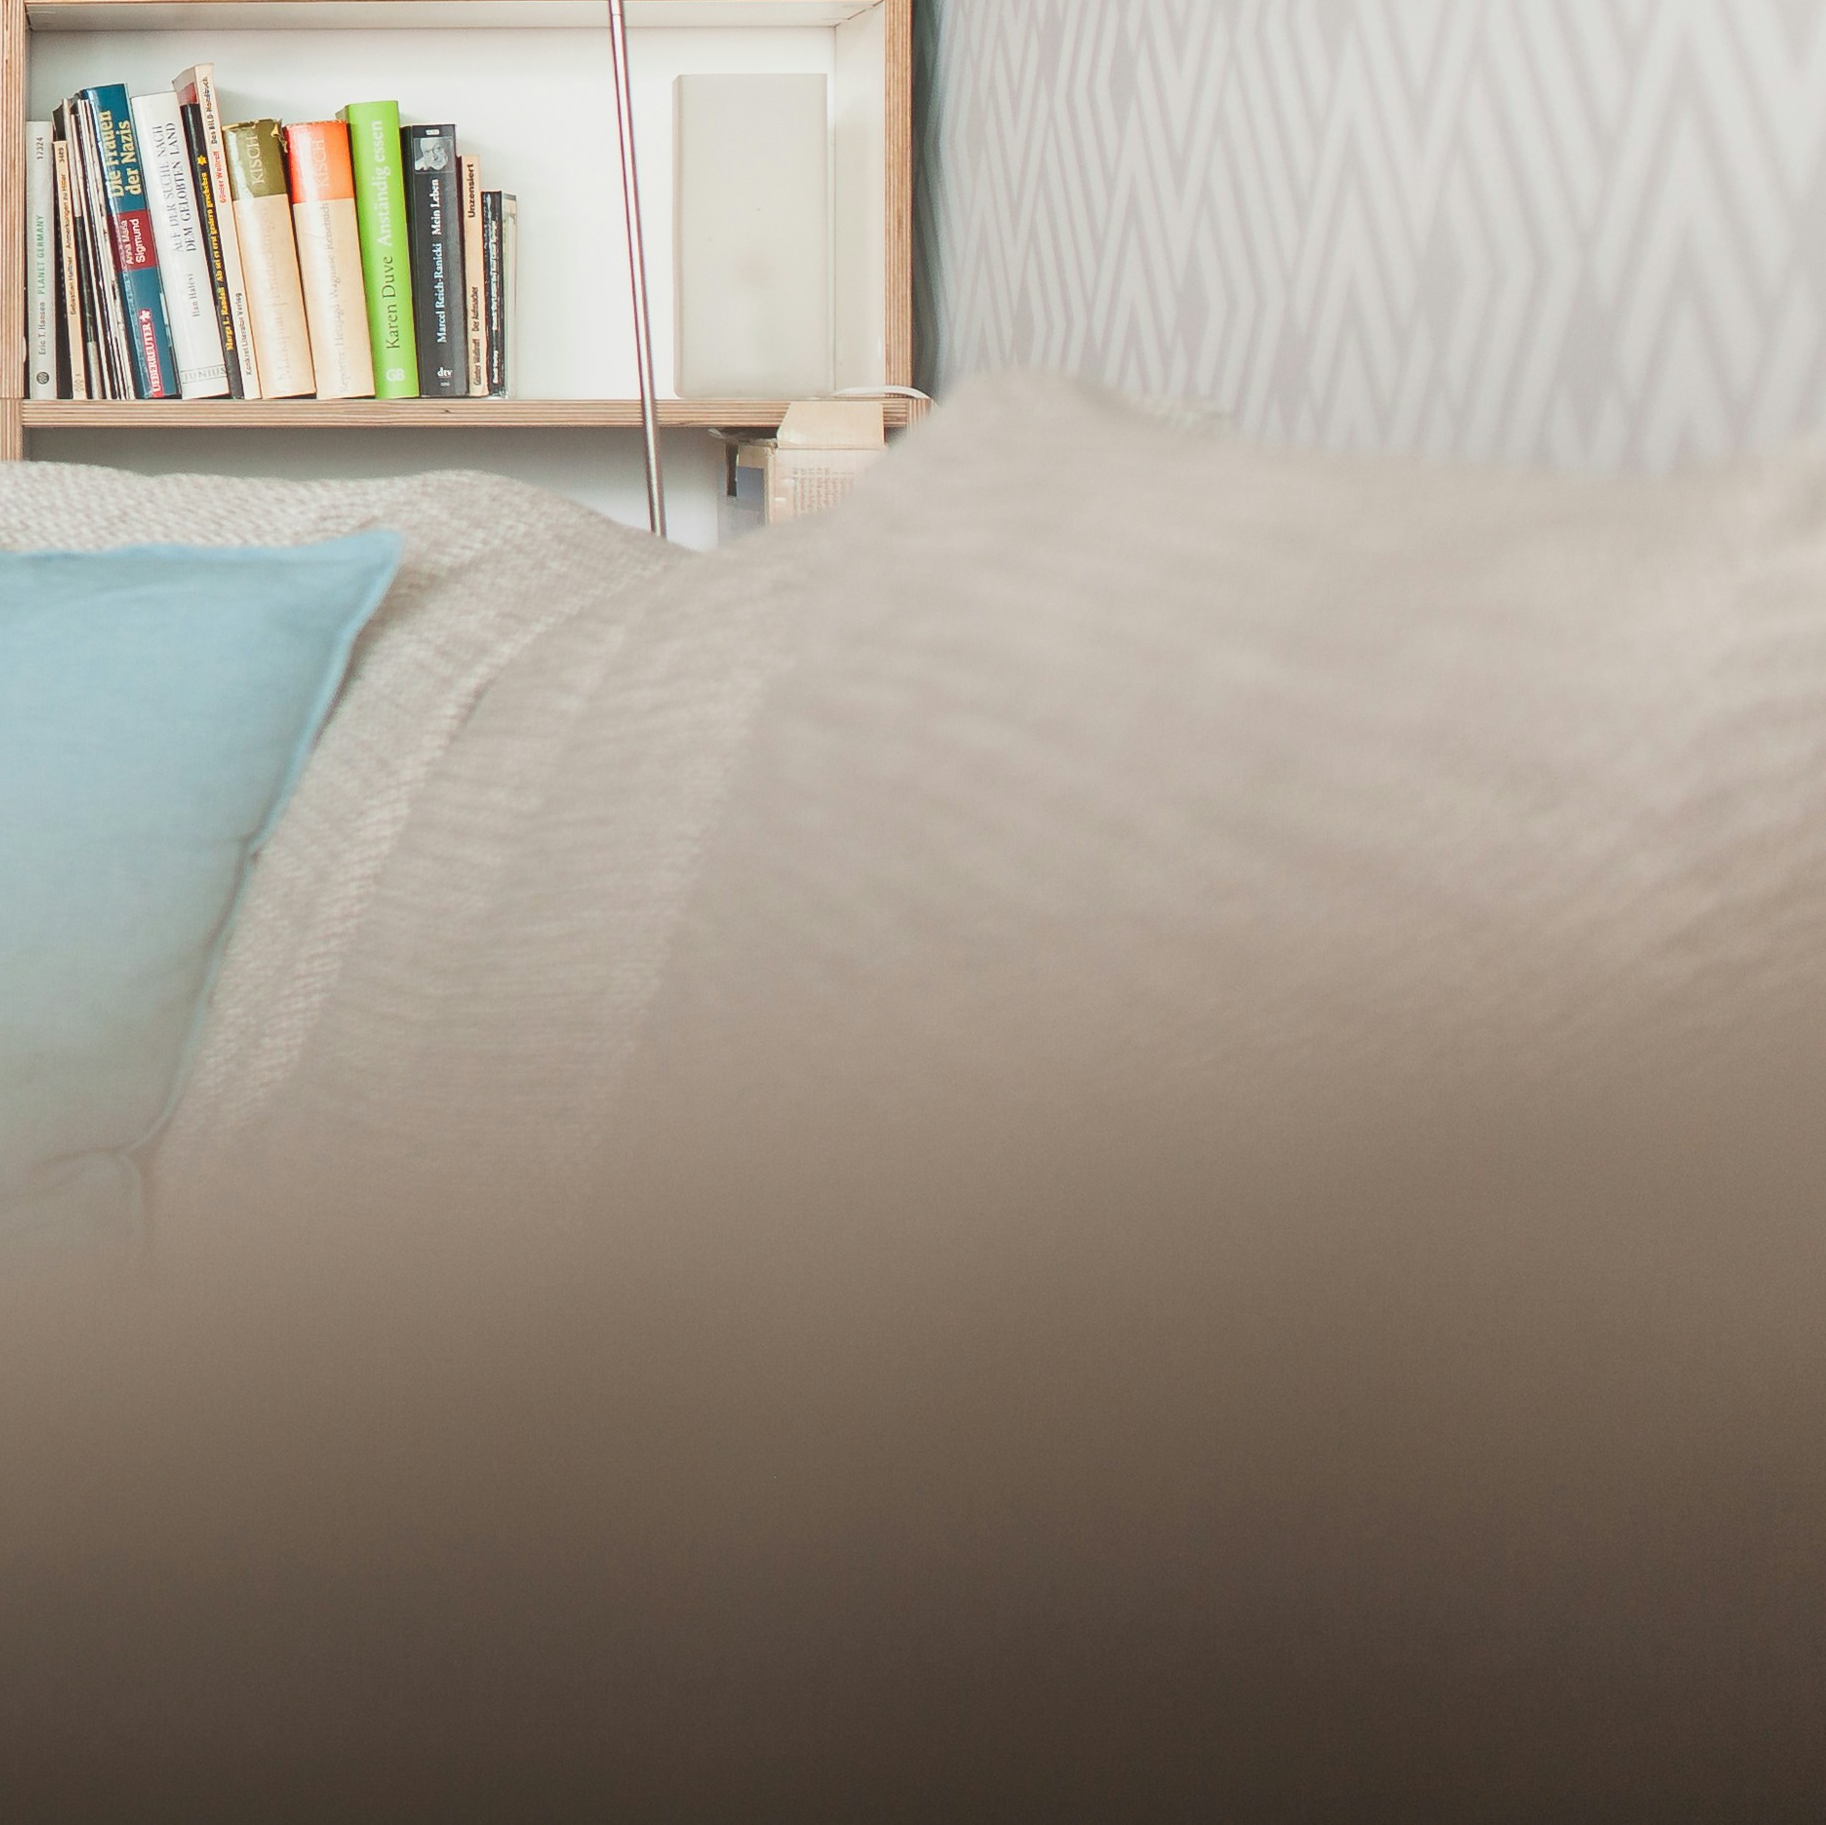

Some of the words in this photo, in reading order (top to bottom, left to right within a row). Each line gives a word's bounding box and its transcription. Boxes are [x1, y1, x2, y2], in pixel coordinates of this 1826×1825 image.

[99, 111, 119, 166] Frauen
[116, 121, 136, 164] Nazis
[370, 121, 384, 162] essen
[106, 172, 124, 197] Die
[126, 169, 140, 194] der
[372, 166, 392, 246] Anständig
[381, 256, 397, 298] Duve
[383, 304, 400, 349] Karen
